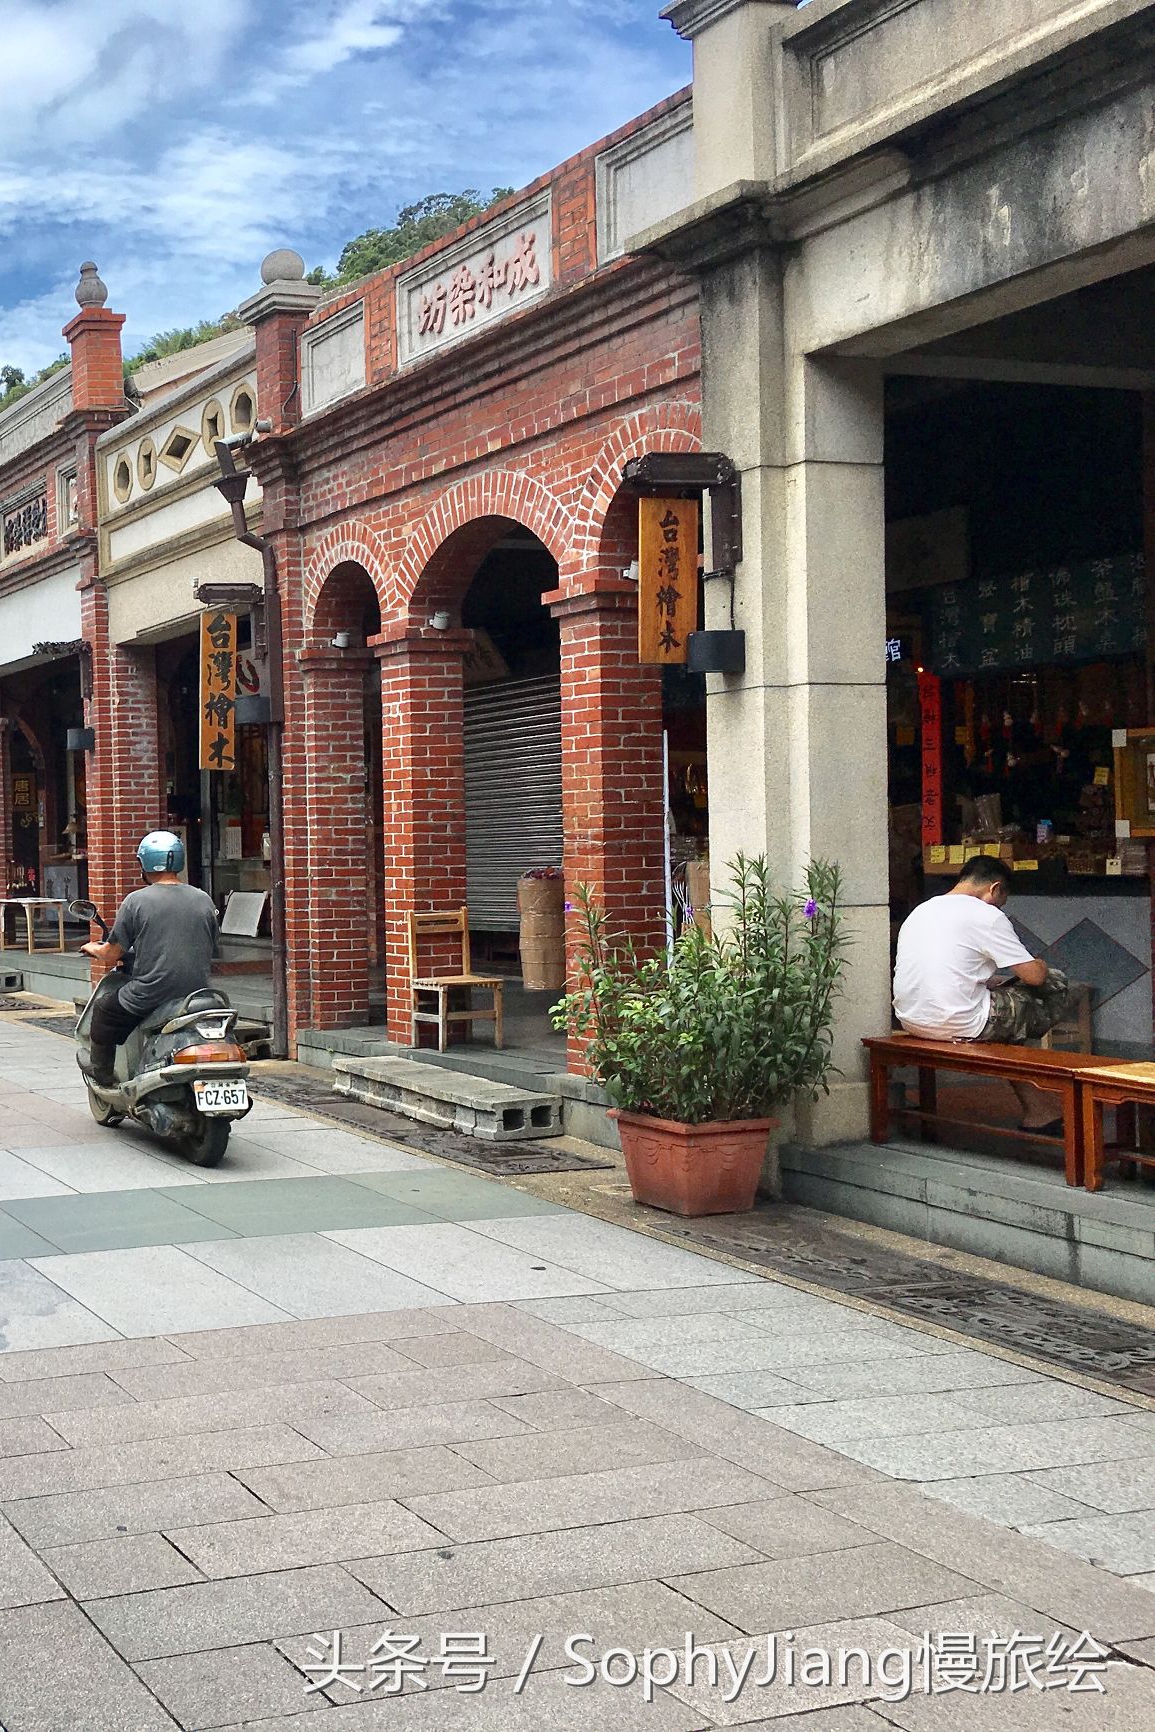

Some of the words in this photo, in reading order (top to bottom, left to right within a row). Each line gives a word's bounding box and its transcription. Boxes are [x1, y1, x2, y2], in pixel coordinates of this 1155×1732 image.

[655, 510, 683, 654] 台灣檜木
[204, 614, 236, 768] 台灣檜木
